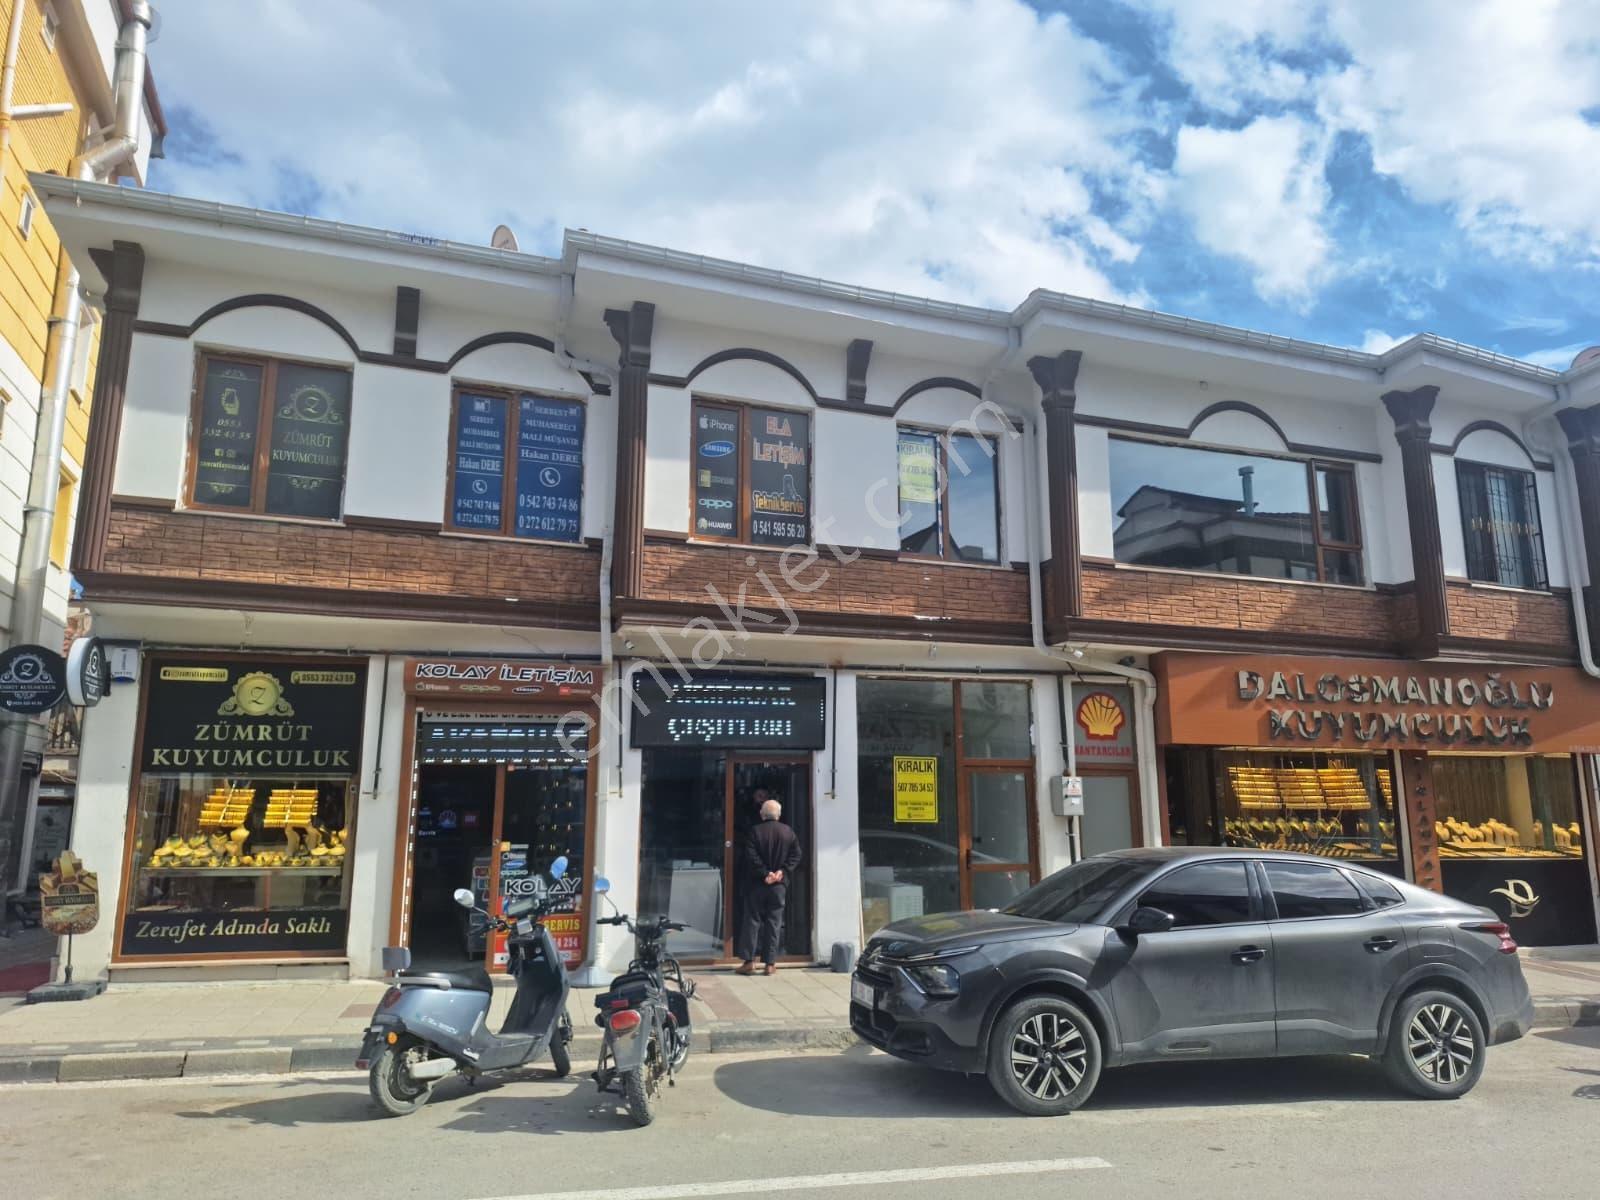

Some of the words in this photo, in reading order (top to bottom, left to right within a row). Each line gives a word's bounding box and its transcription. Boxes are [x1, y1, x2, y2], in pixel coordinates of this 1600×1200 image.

[709, 419, 735, 431] iPhone
[766, 416, 792, 436] ELA
[459, 456, 480, 470] Hakan
[481, 459, 501, 472] DERE
[521, 448, 549, 460] Hakan
[552, 452, 579, 464] DERE
[520, 494, 525, 507] 0
[527, 494, 540, 509] 542
[542, 496, 556, 510] 743
[558, 497, 567, 510] 74
[568, 498, 578, 512] 86
[698, 498, 733, 510] oppo
[519, 514, 524, 528] 0
[525, 515, 540, 530] 272
[541, 516, 555, 530] 612
[557, 518, 567, 532] 79
[568, 519, 577, 532] 75
[708, 521, 732, 530] HUAWEI
[753, 520, 758, 534] 0
[759, 521, 772, 535] 541
[773, 522, 785, 537] 595
[786, 523, 796, 538] 56
[796, 524, 805, 538] 20
[416, 663, 496, 679] KOLAY
[500, 663, 593, 686] İLETİŞİM
[459, 683, 502, 692] oppo
[1237, 670, 1555, 710] DALOSMANOĞLU
[194, 720, 313, 742] ZÜMRÜT
[1269, 708, 1534, 746] KUYUMCULUK
[151, 748, 350, 766] KUYUMCULUK
[505, 878, 582, 896] KOLAY
[135, 919, 207, 944] Zerafet
[209, 918, 279, 937] Adında
[284, 917, 331, 935] Saklı
